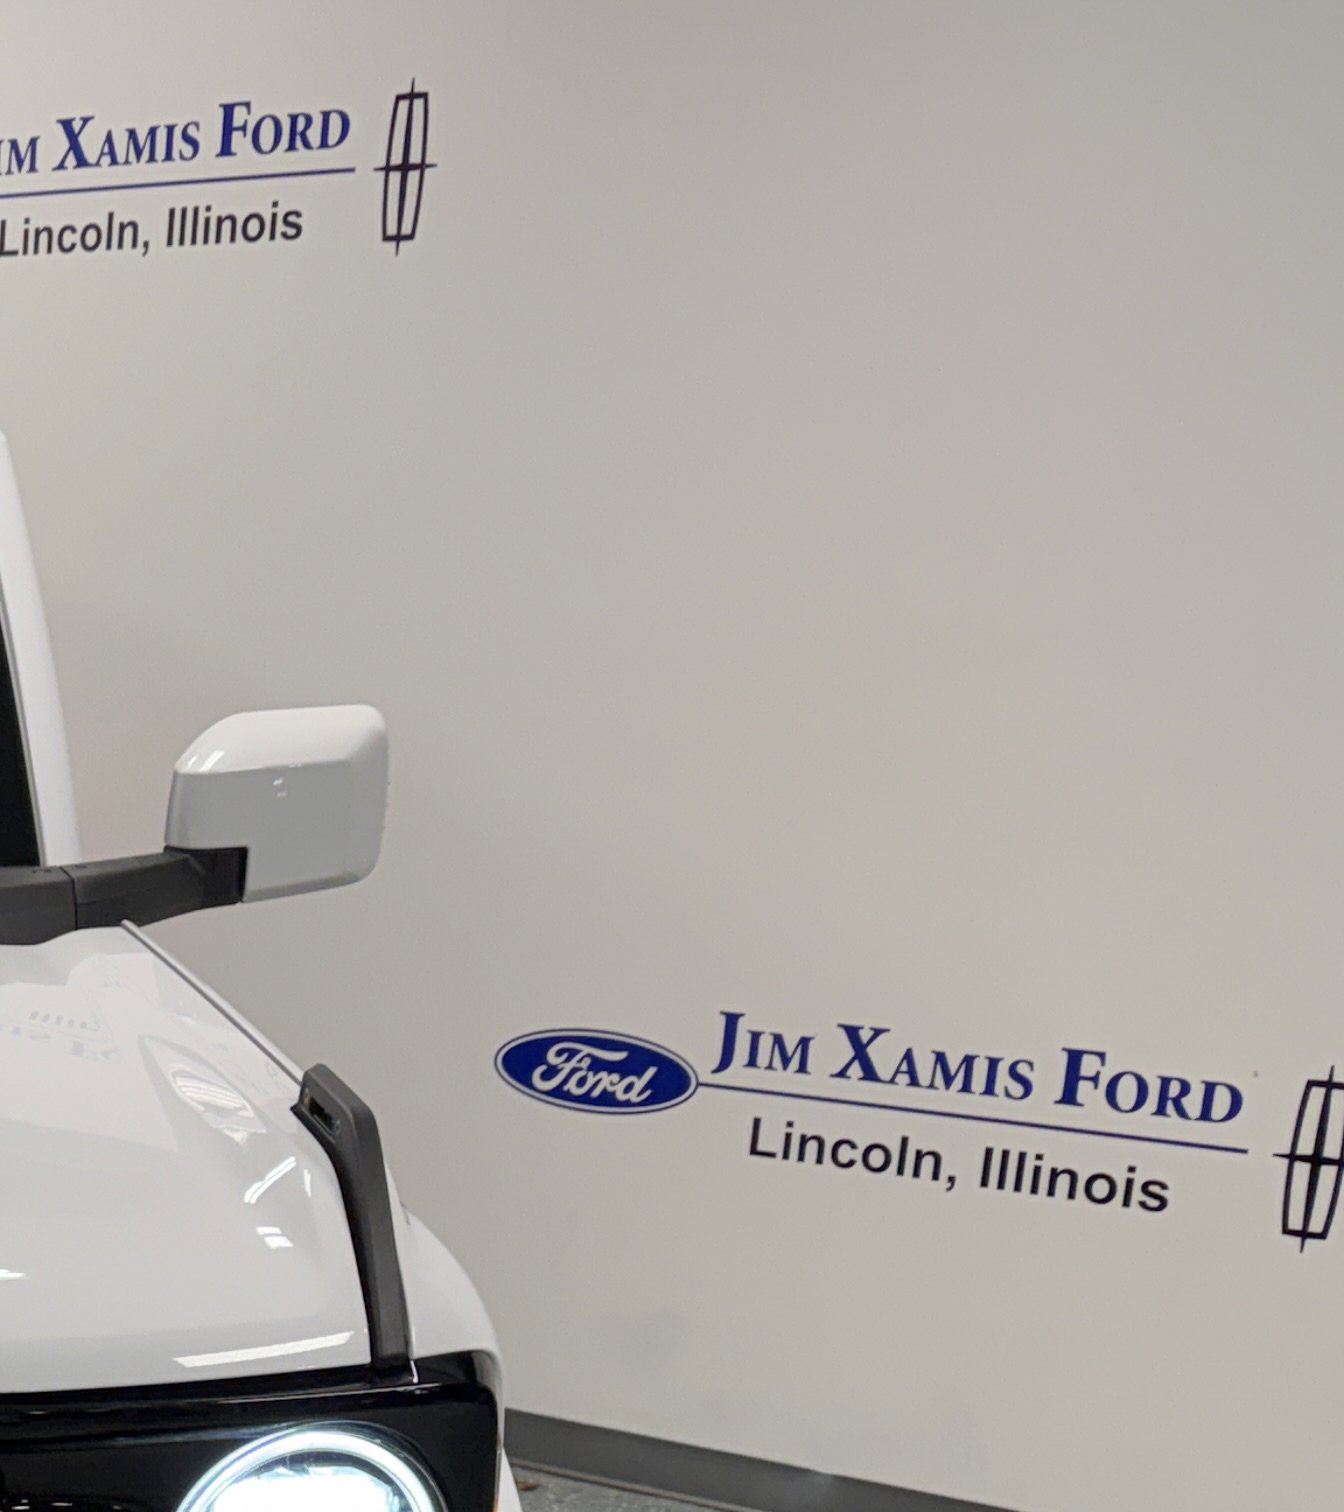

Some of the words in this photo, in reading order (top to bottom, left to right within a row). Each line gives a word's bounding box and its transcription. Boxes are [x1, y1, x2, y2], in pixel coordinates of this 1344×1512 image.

[52, 115, 200, 171] XAMIS
[215, 101, 350, 157] FORD
[166, 201, 303, 248] Illinois
[532, 1040, 658, 1106] Ford
[711, 1011, 813, 1076] JIM
[831, 1023, 1035, 1102] XAMIS
[1054, 1047, 1243, 1124] FORD
[748, 1116, 958, 1193] Lincoln,
[979, 1146, 1170, 1214] Illinois
